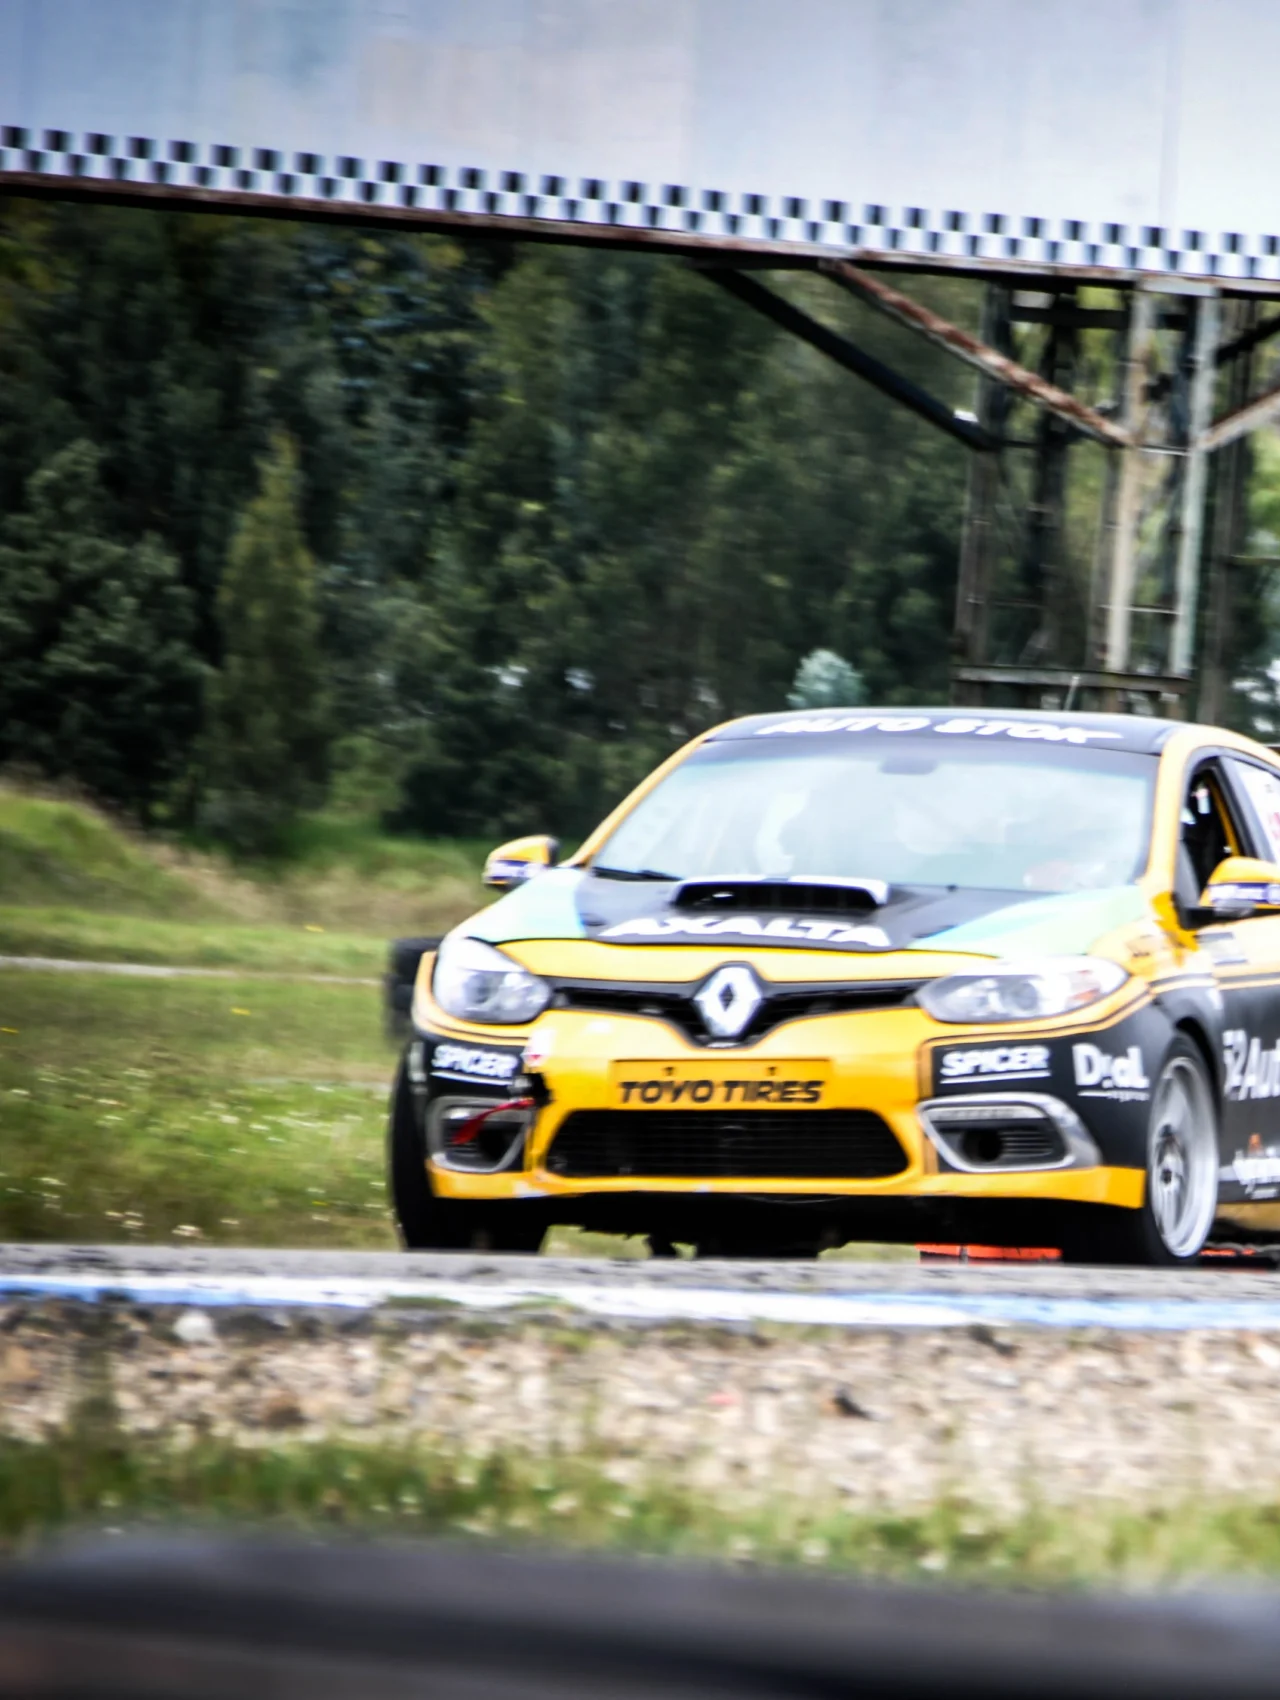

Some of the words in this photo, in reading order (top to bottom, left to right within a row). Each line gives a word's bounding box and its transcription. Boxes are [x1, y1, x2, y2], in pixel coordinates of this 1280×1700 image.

[753, 716, 931, 736] AUTO
[597, 916, 892, 947] AXALTA
[431, 1044, 519, 1078] SPICER
[940, 1044, 1050, 1077] SPICER
[619, 1079, 714, 1104] TOYO
[722, 1079, 826, 1104] TIRES
